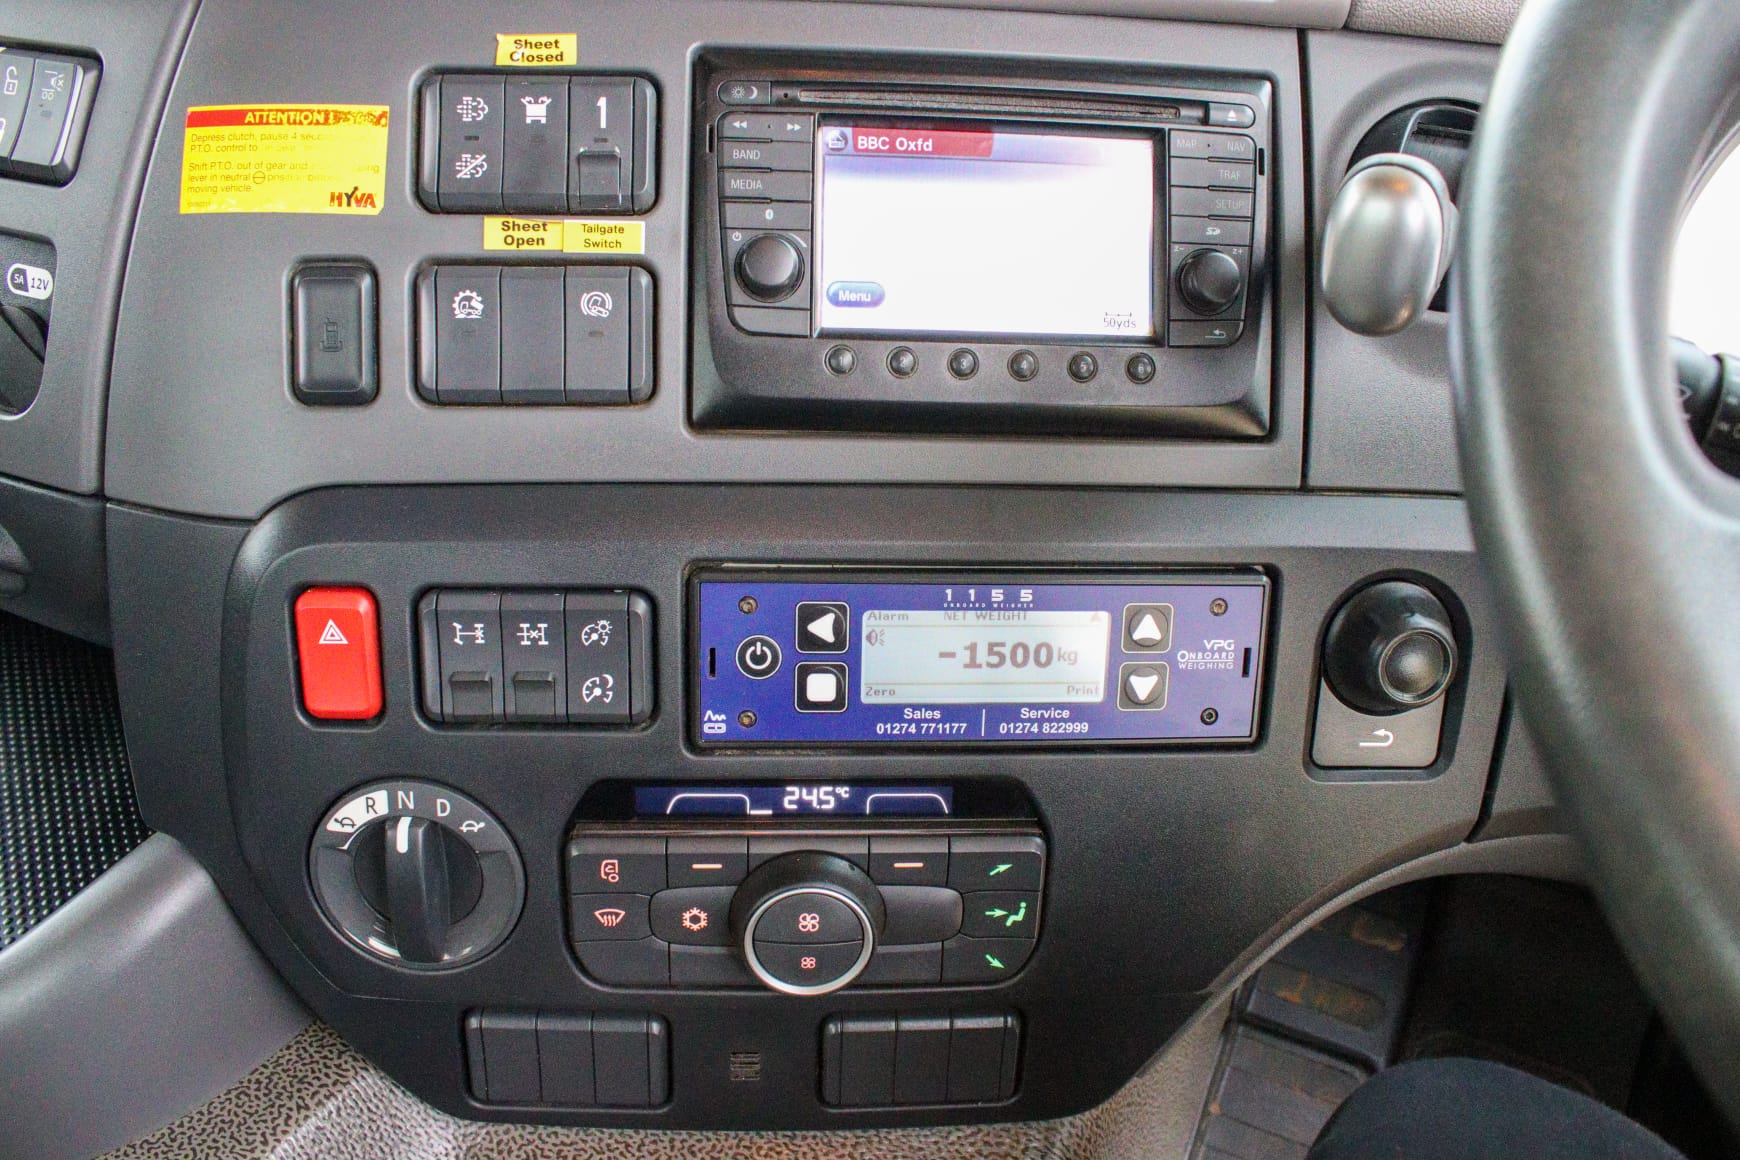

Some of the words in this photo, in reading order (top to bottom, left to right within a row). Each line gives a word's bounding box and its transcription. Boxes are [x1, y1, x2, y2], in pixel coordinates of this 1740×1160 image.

[514, 39, 560, 49] Sheet
[510, 51, 564, 62] Closed
[244, 111, 324, 124] ATTENTION
[191, 134, 225, 142] Depress
[260, 133, 288, 142] pause
[216, 144, 246, 152] control
[249, 144, 258, 152] to
[858, 136, 890, 150] BBC
[896, 136, 933, 152] Oxfd
[1177, 139, 1198, 148] MAP
[1228, 142, 1246, 152] NAV
[732, 149, 760, 160] BAND
[236, 162, 251, 170] out
[254, 161, 264, 170] of
[266, 162, 286, 172] gear
[220, 173, 250, 182] neutral
[730, 178, 762, 190] MEDIA
[187, 186, 218, 194] moving
[330, 186, 376, 208] HYVA
[1216, 200, 1244, 210] SETUP
[502, 220, 548, 232] Sheet
[582, 224, 625, 235] Tailgate
[504, 234, 546, 248] Open
[584, 238, 622, 249] Switch
[30, 276, 50, 292] 12V
[838, 290, 872, 302] Menu
[1104, 318, 1136, 330] 50yds
[867, 610, 909, 621] Alarm
[944, 611, 968, 621] NET
[975, 611, 1028, 621] WEIGHT
[1204, 640, 1234, 650] VPG
[938, 642, 1054, 669] -1500
[1057, 647, 1078, 665] kg
[1178, 662, 1234, 670] WEIGHING
[865, 686, 896, 697] Zero
[1066, 686, 1100, 696] Print
[904, 708, 941, 720] Sales
[1020, 707, 1070, 720] Service
[876, 723, 916, 734] 01274
[920, 723, 968, 734] 771177
[1000, 722, 1038, 734] 01274
[1042, 722, 1088, 734] 822999
[366, 796, 378, 814] R
[397, 790, 414, 810] N
[436, 798, 450, 816] D
